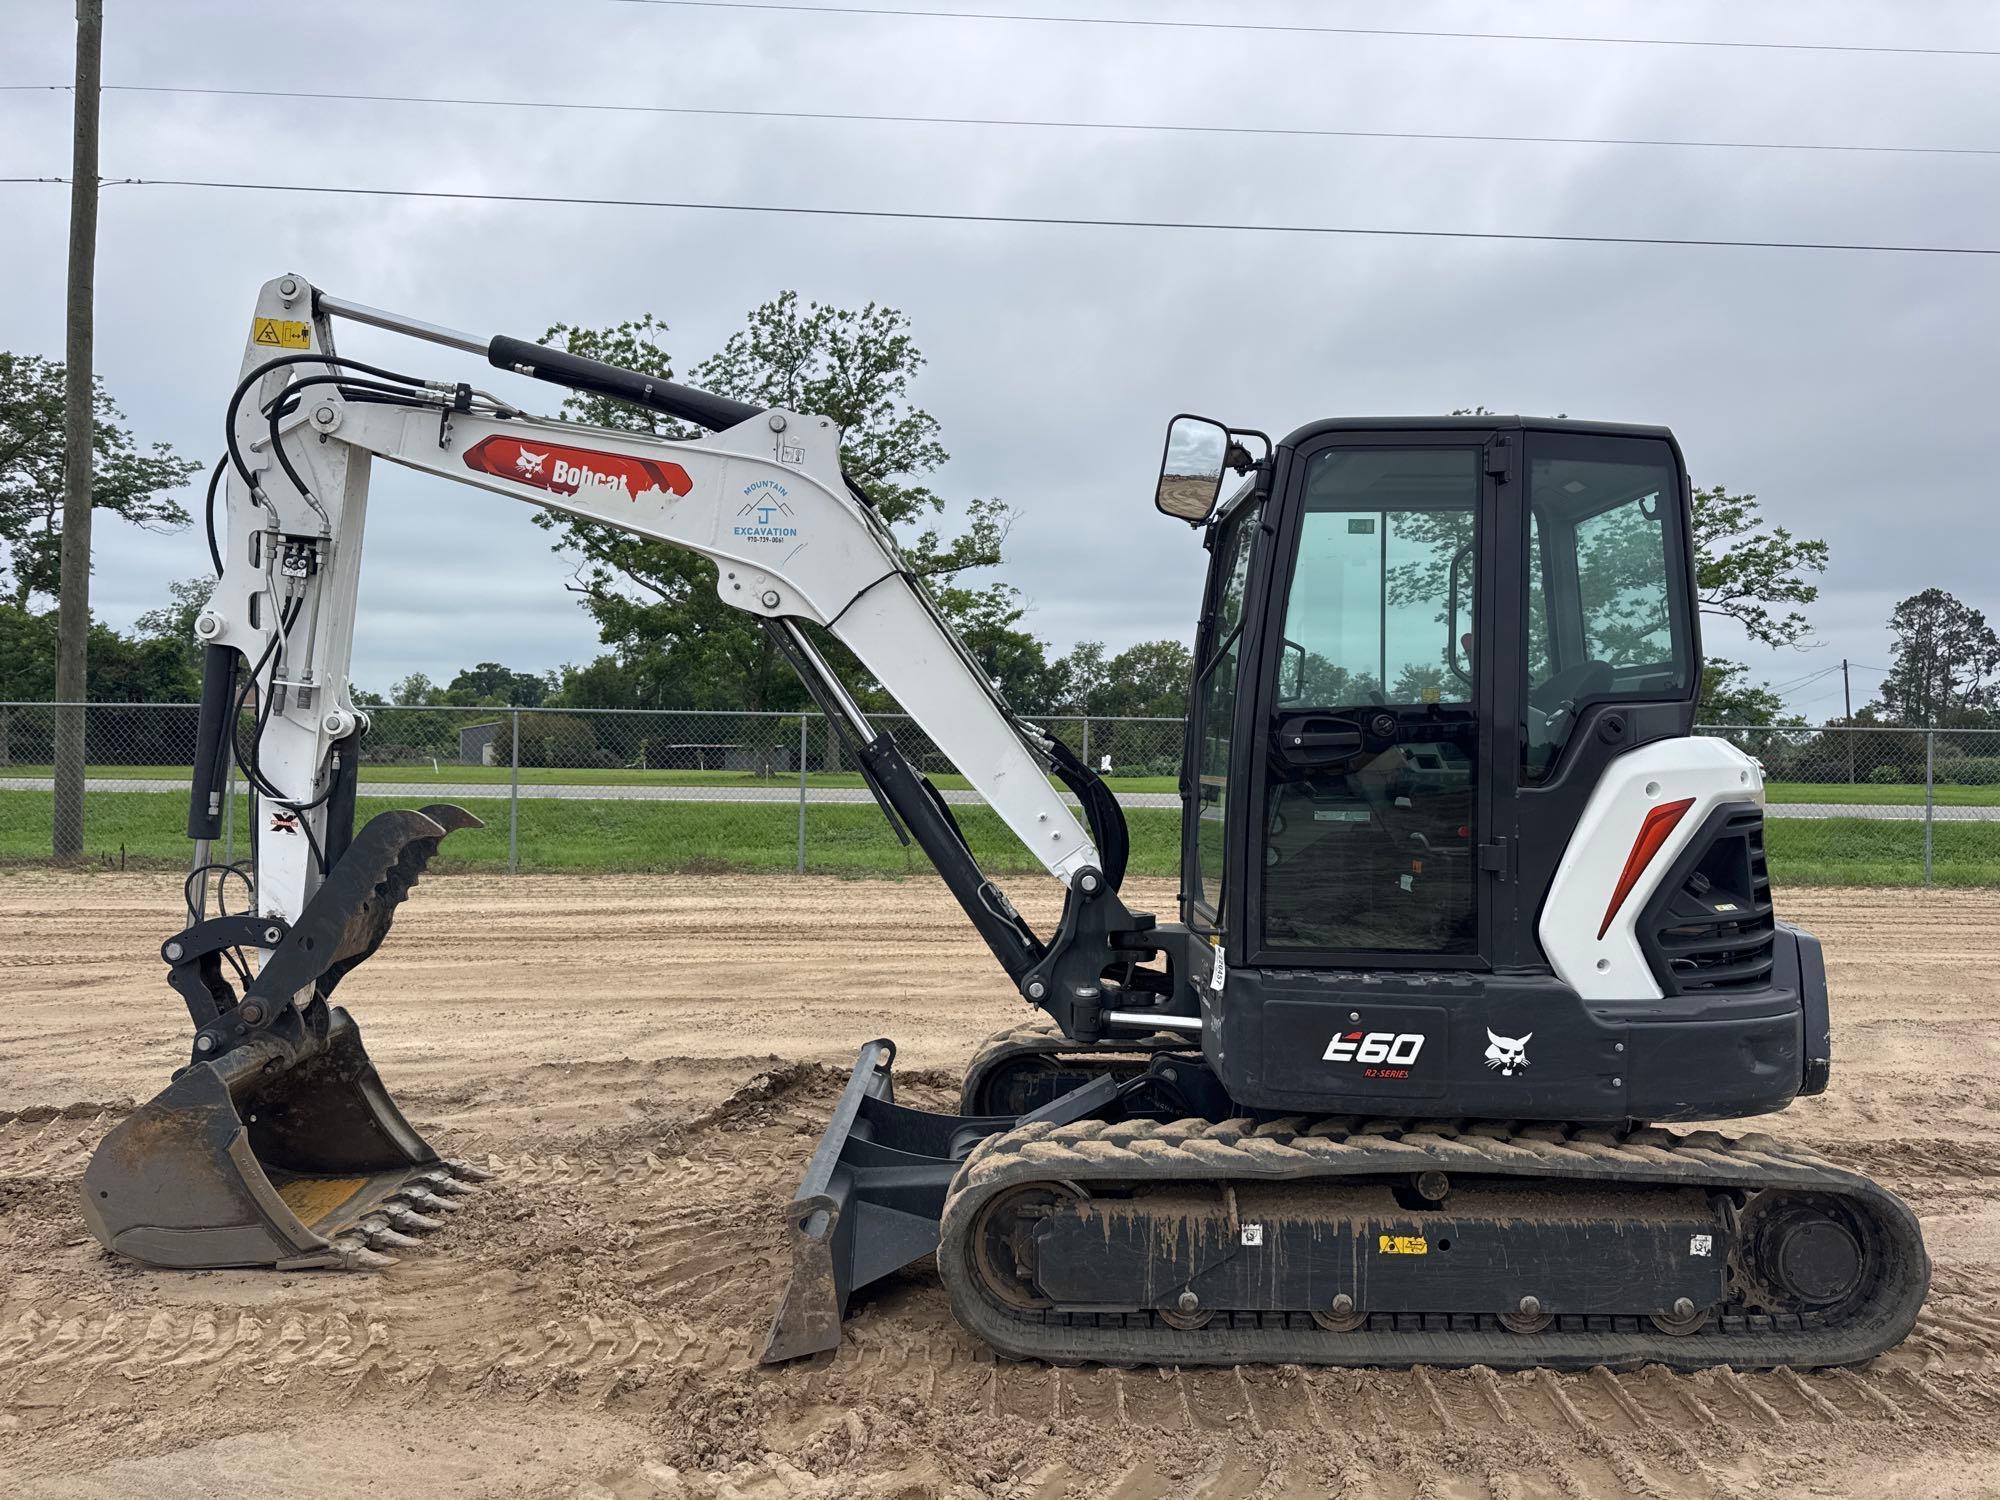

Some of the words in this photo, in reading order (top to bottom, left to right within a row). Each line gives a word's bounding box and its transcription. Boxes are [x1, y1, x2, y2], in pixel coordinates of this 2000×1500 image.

[552, 459, 628, 491] Bobcat
[743, 480, 788, 497] MOUNTAIN
[734, 527, 797, 536] EXCAVATION
[1322, 1031, 1426, 1065] E60
[1364, 1068, 1409, 1079] R2-SERIES
